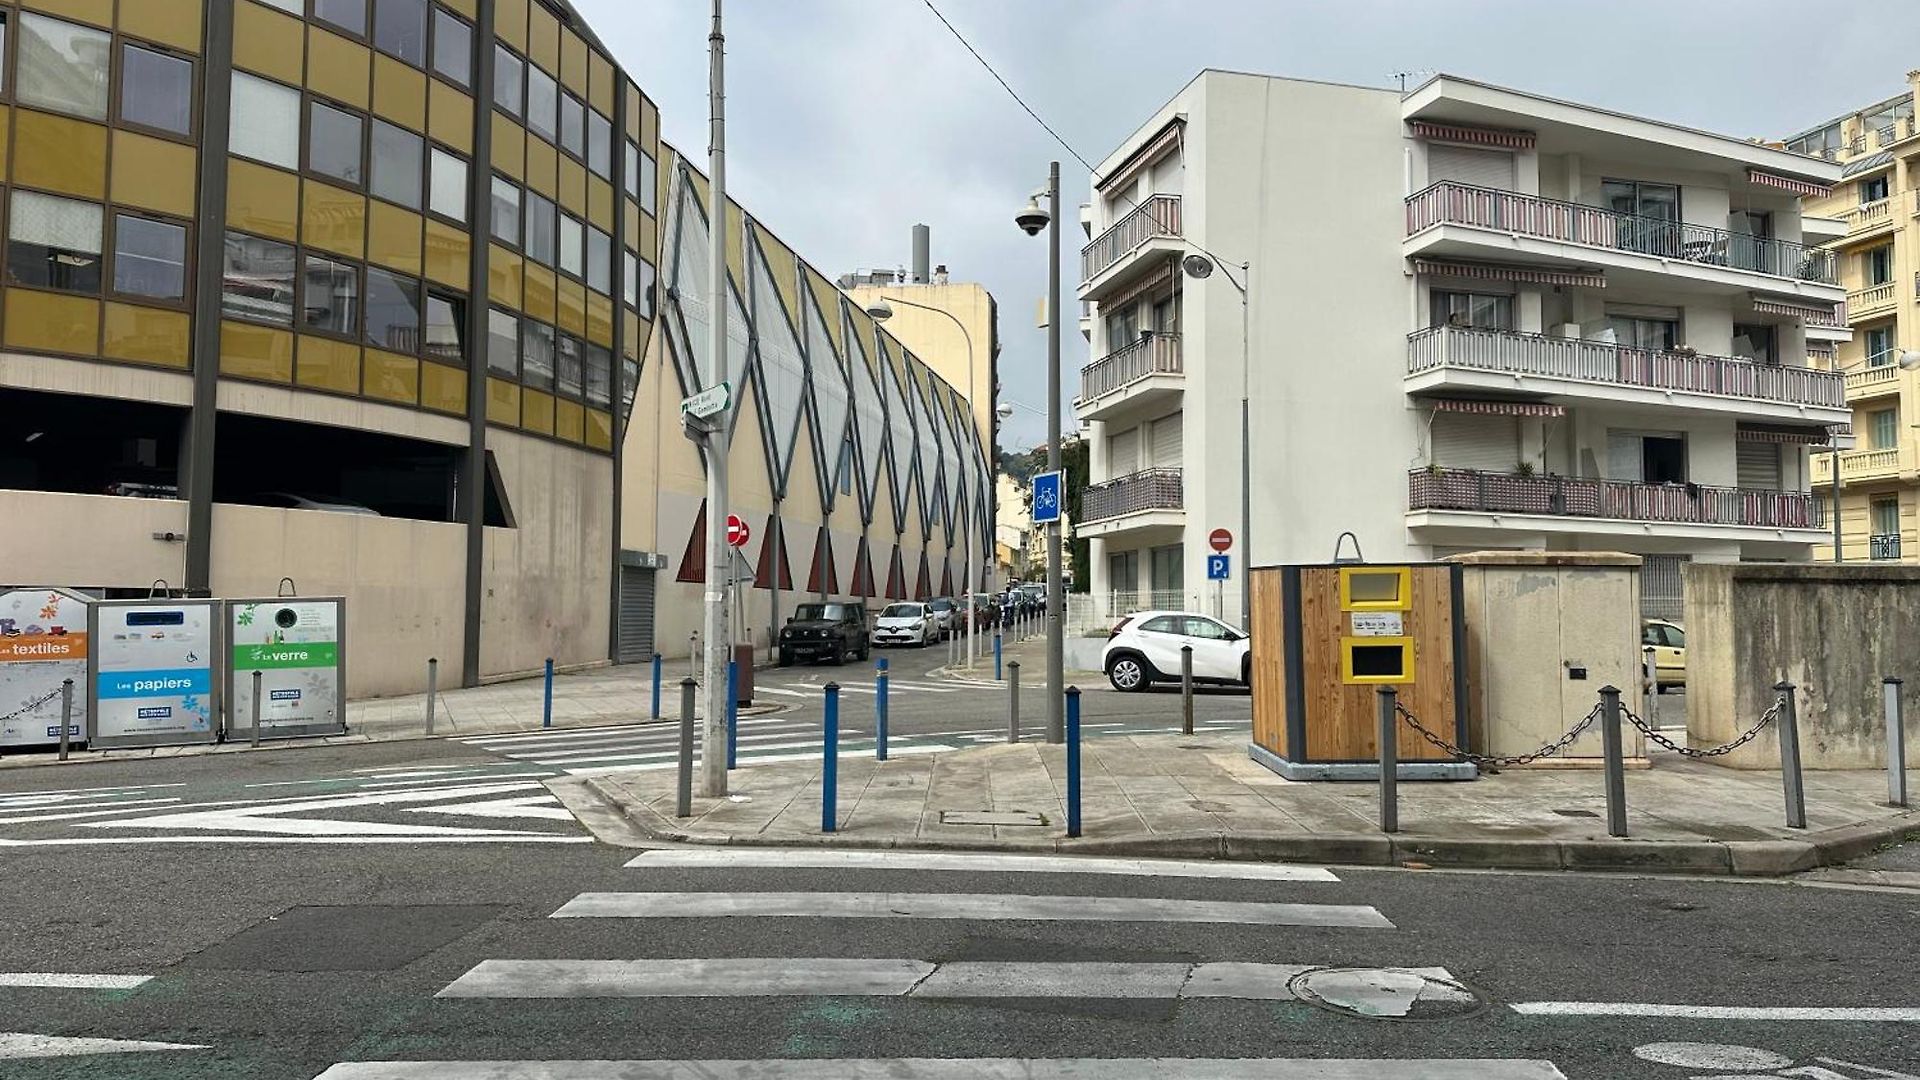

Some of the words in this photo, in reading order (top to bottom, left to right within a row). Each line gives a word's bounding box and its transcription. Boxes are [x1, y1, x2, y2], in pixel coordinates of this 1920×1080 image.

[1213, 560, 1223, 575] P
[12, 642, 70, 655] textiles
[272, 651, 308, 661] verre
[134, 677, 192, 692] papiers
